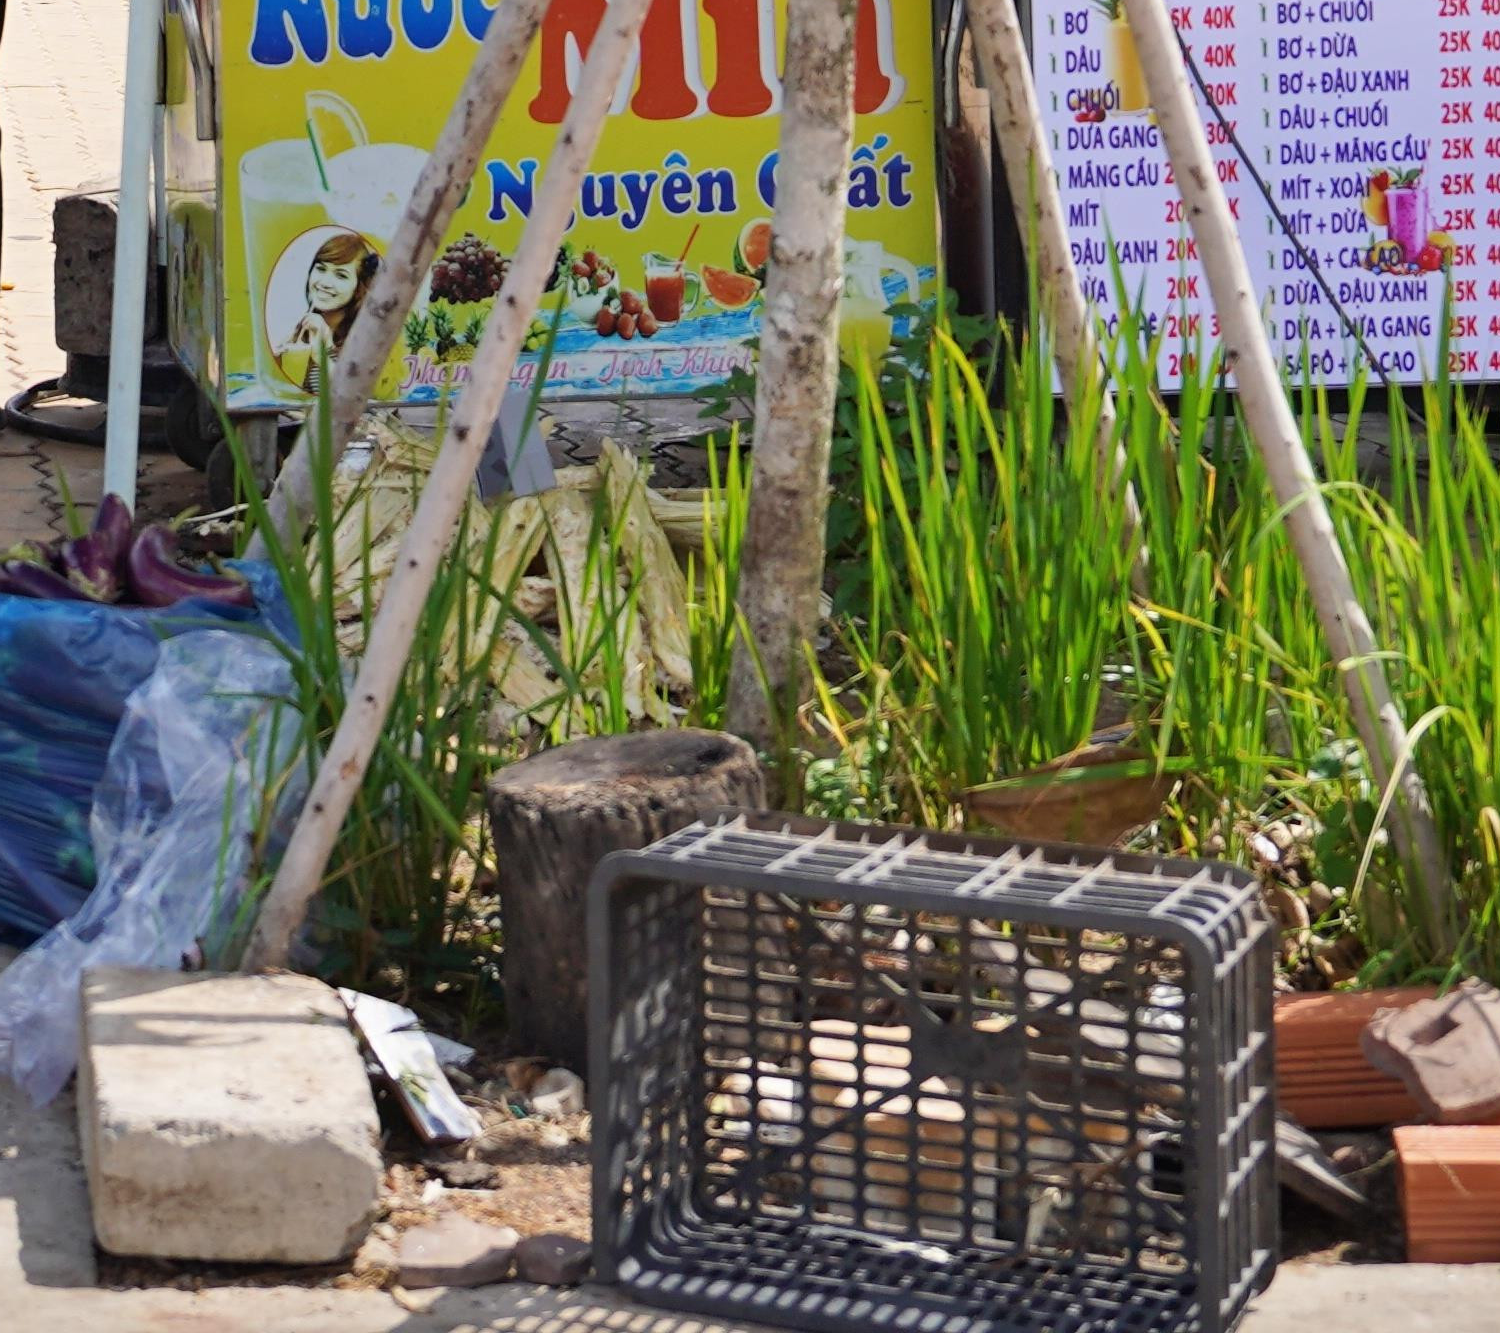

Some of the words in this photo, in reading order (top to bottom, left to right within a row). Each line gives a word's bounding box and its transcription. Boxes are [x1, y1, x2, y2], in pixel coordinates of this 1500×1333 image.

[1277, 1, 1301, 24] BƠ
[1066, 46, 1101, 73] DÂU
[1204, 44, 1237, 68] 40K
[1278, 37, 1302, 59] BƠ
[1321, 32, 1358, 58] DỪA
[1439, 31, 1471, 53] 25K
[1279, 71, 1302, 94] BƠ
[1321, 67, 1356, 98] ĐẬU
[1361, 69, 1409, 92] XANH
[1440, 66, 1471, 88] 25K
[1280, 104, 1315, 129] DÂU
[1334, 99, 1388, 128] CHUỐI
[1441, 102, 1473, 124] 25K
[1068, 123, 1104, 149] DƯA
[1109, 126, 1158, 149] GANG
[486, 152, 738, 230] Nuyên
[1069, 199, 1100, 227] MÍT
[1282, 209, 1312, 235] MÍT
[1331, 208, 1368, 233] DỪA
[1444, 209, 1475, 230] 25K
[1167, 276, 1199, 300] 20K
